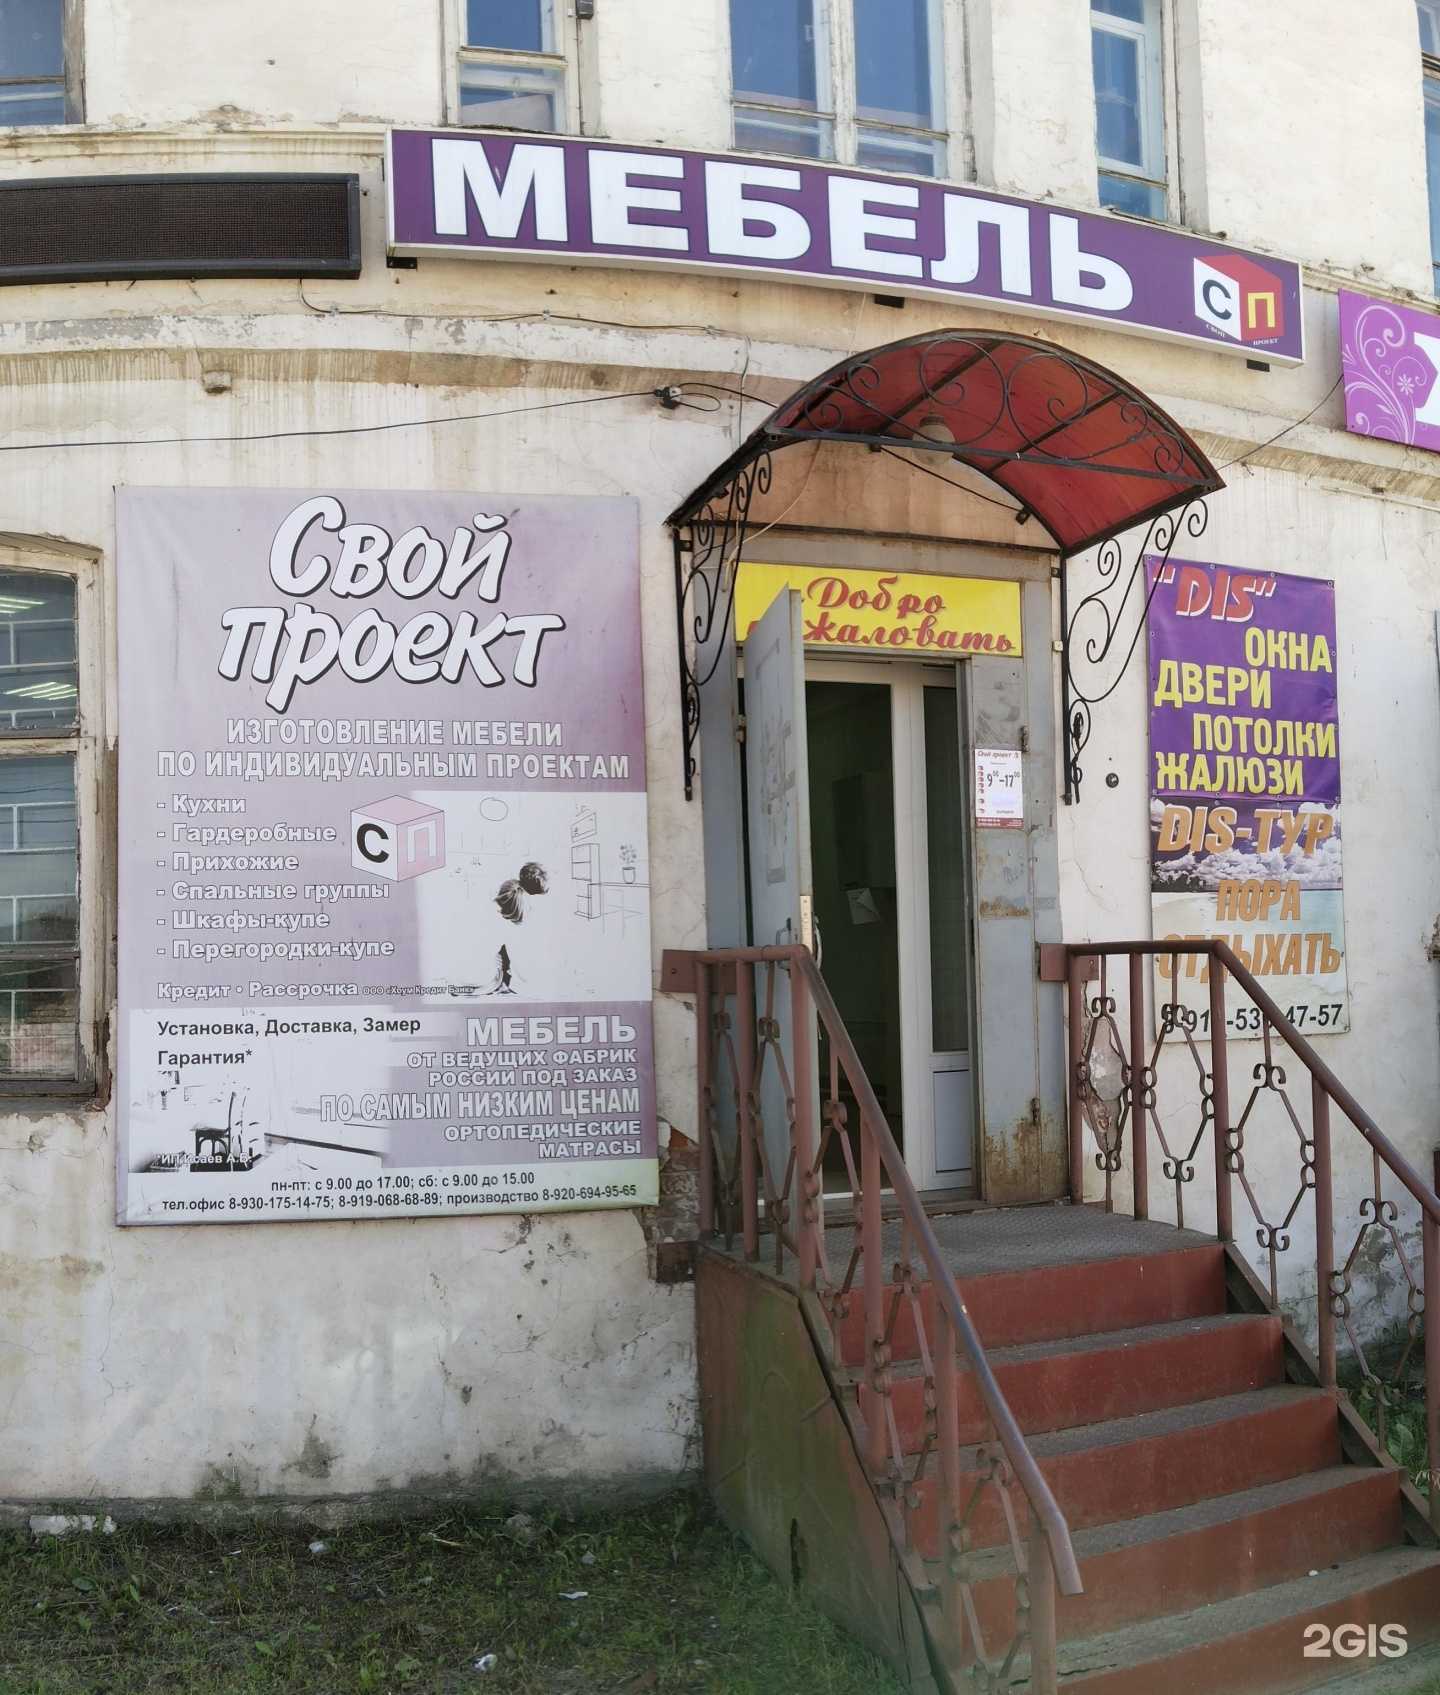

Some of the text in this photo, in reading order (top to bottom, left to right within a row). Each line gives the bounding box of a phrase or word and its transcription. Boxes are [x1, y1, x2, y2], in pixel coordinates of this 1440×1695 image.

[430, 137, 1135, 313] МЕБЕЛЬ
[268, 495, 512, 602] Свой
[807, 576, 946, 619] Добро
[747, 612, 1015, 652] жаловать
[217, 602, 566, 714] проект
[1245, 627, 1332, 673] ОКНА
[1154, 660, 1272, 709] ДВЕРИ
[227, 717, 563, 747] ИЗГОТОВЛЕНИЕ МЕБЕЛИ
[1193, 713, 1337, 758] ПОТОЛКИ
[157, 750, 630, 782] ПО ИНДИВИДУАЛЬНЫМ ПРОЕКТАМ
[1155, 751, 1304, 796] ЖАЛЮЗИ
[172, 794, 246, 816] Кухни
[172, 823, 337, 846] Гардеробные
[172, 851, 299, 875] Прихожие
[172, 881, 390, 903] Спальные группы
[1216, 879, 1302, 922] ПОРА
[172, 909, 330, 933] Шкафы-купе
[172, 939, 395, 962] Перегородки-купе
[157, 981, 358, 1002] Кредит Рассрочка
[363, 985, 384, 996] ООО
[157, 1017, 421, 1036] Установка, Доставка, Замер
[466, 1015, 637, 1047] МЕБЕЛЬ
[407, 1048, 637, 1069] ОТ ВЕДУЩИХ ФАБРИК
[428, 1068, 637, 1087] РОССИИ ПОД ЗАКАЗ
[320, 1088, 640, 1122] ПО САМЫМ НИЗКИМ ЦЕНАМ
[444, 1120, 641, 1142] ОРТОПЕДИЧЕСКИЕ
[538, 1140, 641, 1159] МАТРАСЫ
[271, 1172, 535, 1191] пн-пт: с 9.00 до 17.00; сб: с 9.00 до 15.00
[162, 1198, 225, 1212] тел.офис
[447, 1189, 539, 1207] производство
[543, 1185, 637, 1200] 8-920-694-95-65
